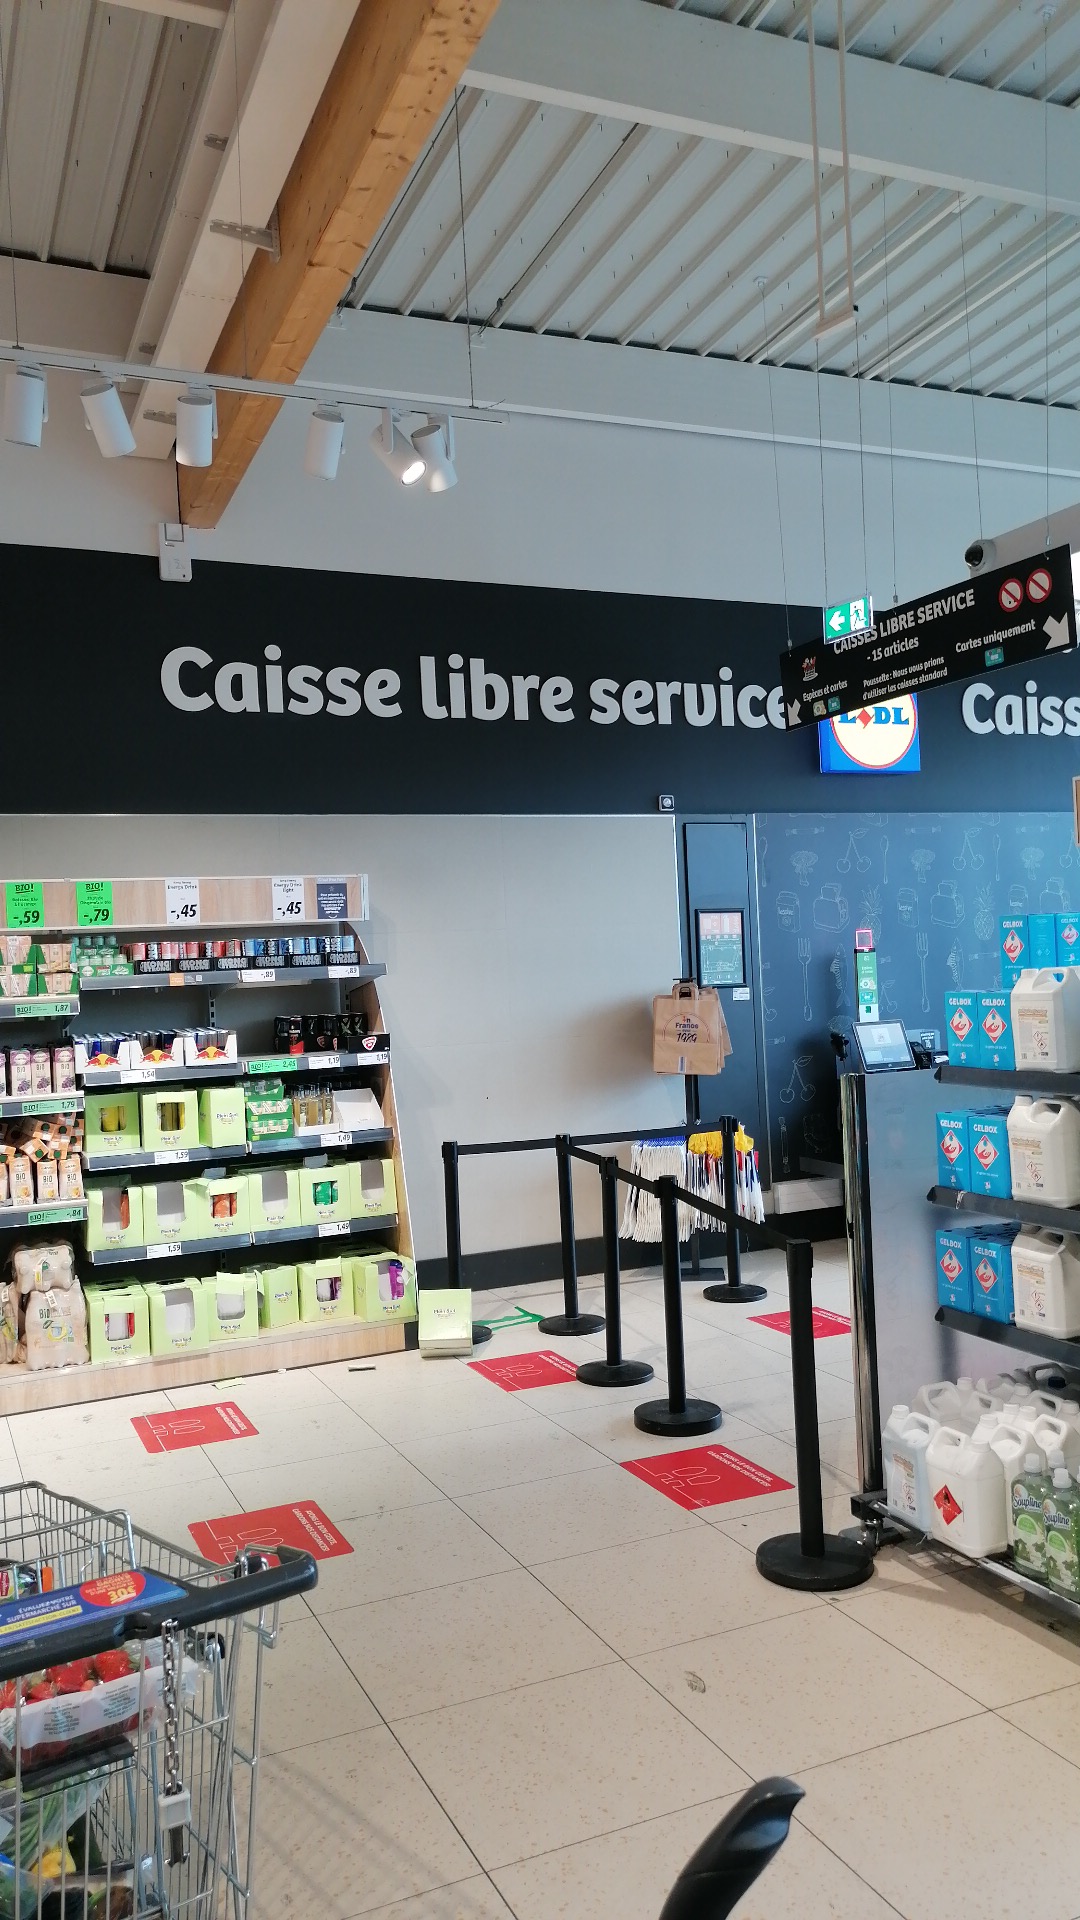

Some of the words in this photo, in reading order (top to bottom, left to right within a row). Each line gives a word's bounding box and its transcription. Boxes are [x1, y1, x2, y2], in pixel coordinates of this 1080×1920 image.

[880, 610, 914, 638] LIBRE
[917, 588, 975, 624] SERVICE
[955, 635, 982, 653] Cartes
[983, 618, 1036, 643] uniquement
[884, 637, 919, 659] articles
[892, 667, 908, 679] Nous
[908, 662, 923, 674] vous
[923, 656, 945, 671] prions
[161, 644, 403, 718] Caisse
[419, 652, 575, 723] libre
[589, 666, 787, 729] service
[887, 684, 897, 694] les
[896, 678, 919, 690] caisses
[918, 666, 948, 684] standard
[802, 685, 824, 703] Espèces
[829, 679, 848, 693] cartes
[1002, 920, 1023, 928] GELBOX
[948, 997, 972, 1006] GELBOX
[981, 998, 1006, 1007] GELBOX
[940, 1119, 963, 1129] GELBOX
[973, 1124, 998, 1134] GELBOX
[940, 1237, 962, 1249] GELBOX
[974, 1246, 997, 1258] GELBOX
[1013, 1495, 1042, 1509] Soupline
[6, 1603, 62, 1623] SUPERMARCHÉ
[61, 1598, 78, 1608] SUR
